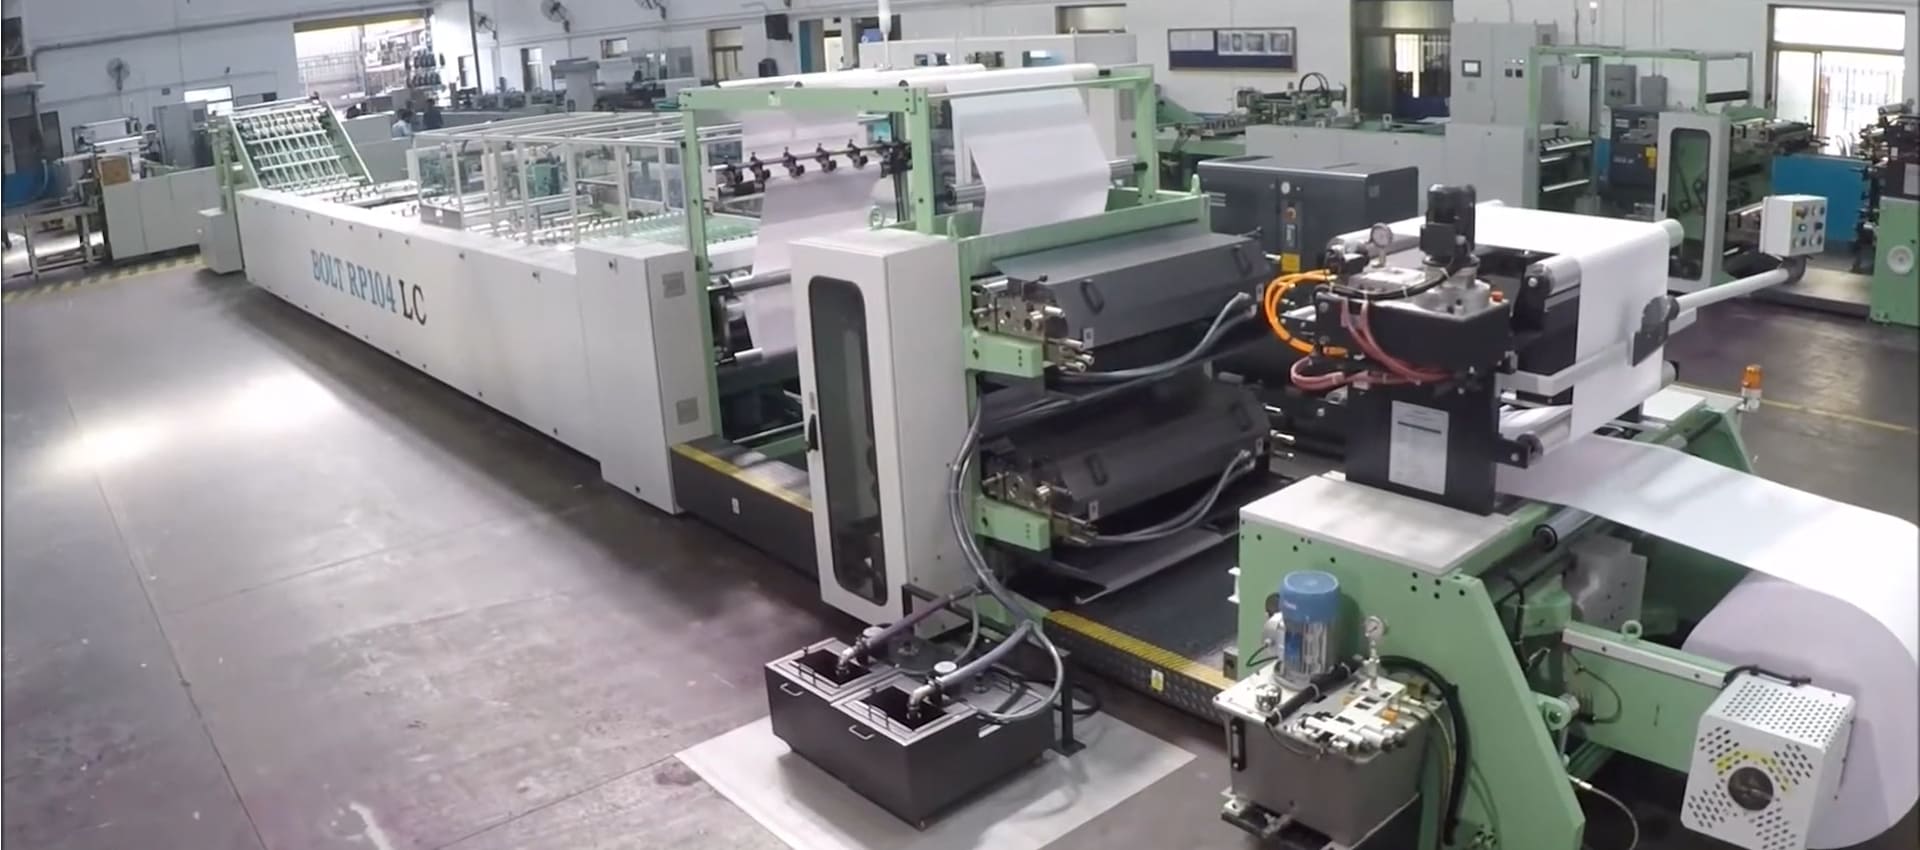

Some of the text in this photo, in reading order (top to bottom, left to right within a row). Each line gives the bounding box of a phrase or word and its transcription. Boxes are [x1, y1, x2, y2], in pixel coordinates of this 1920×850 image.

[310, 248, 427, 326] BOLT RP104 LC
